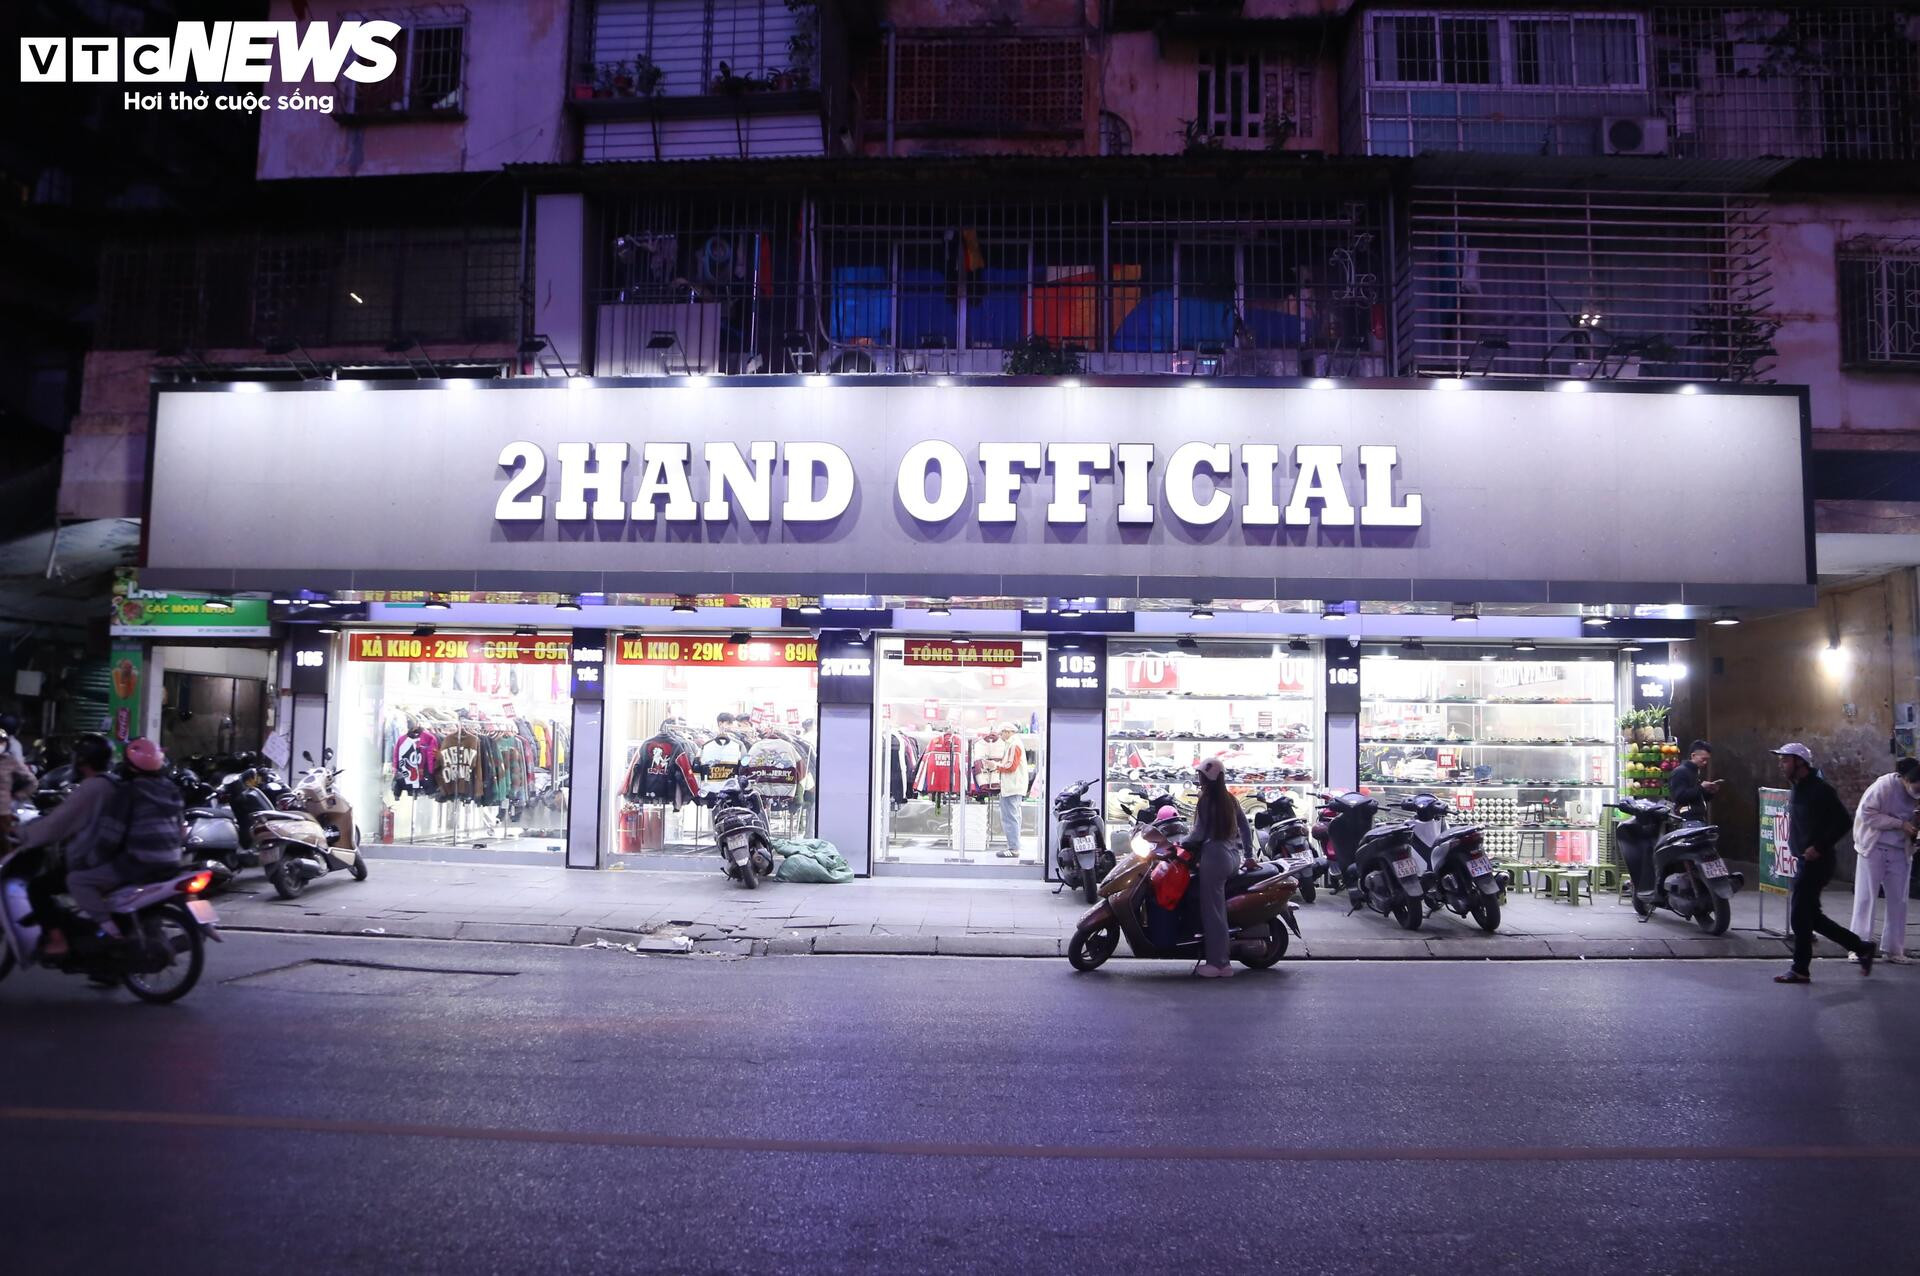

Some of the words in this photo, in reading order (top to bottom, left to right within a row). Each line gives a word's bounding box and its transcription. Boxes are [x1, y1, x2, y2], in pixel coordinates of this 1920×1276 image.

[494, 440, 855, 521] 2HAND
[897, 439, 1423, 527] OFFICIAL
[361, 635, 384, 658] XẢ
[387, 640, 422, 659] KHO
[434, 640, 469, 659] 29K
[483, 641, 519, 660] 69K
[647, 642, 680, 661] KHO
[692, 643, 724, 662] 29K
[785, 643, 818, 662] 89K
[982, 648, 1015, 662] KHO
[1058, 655, 1096, 673] 105
[1329, 668, 1358, 685] 105
